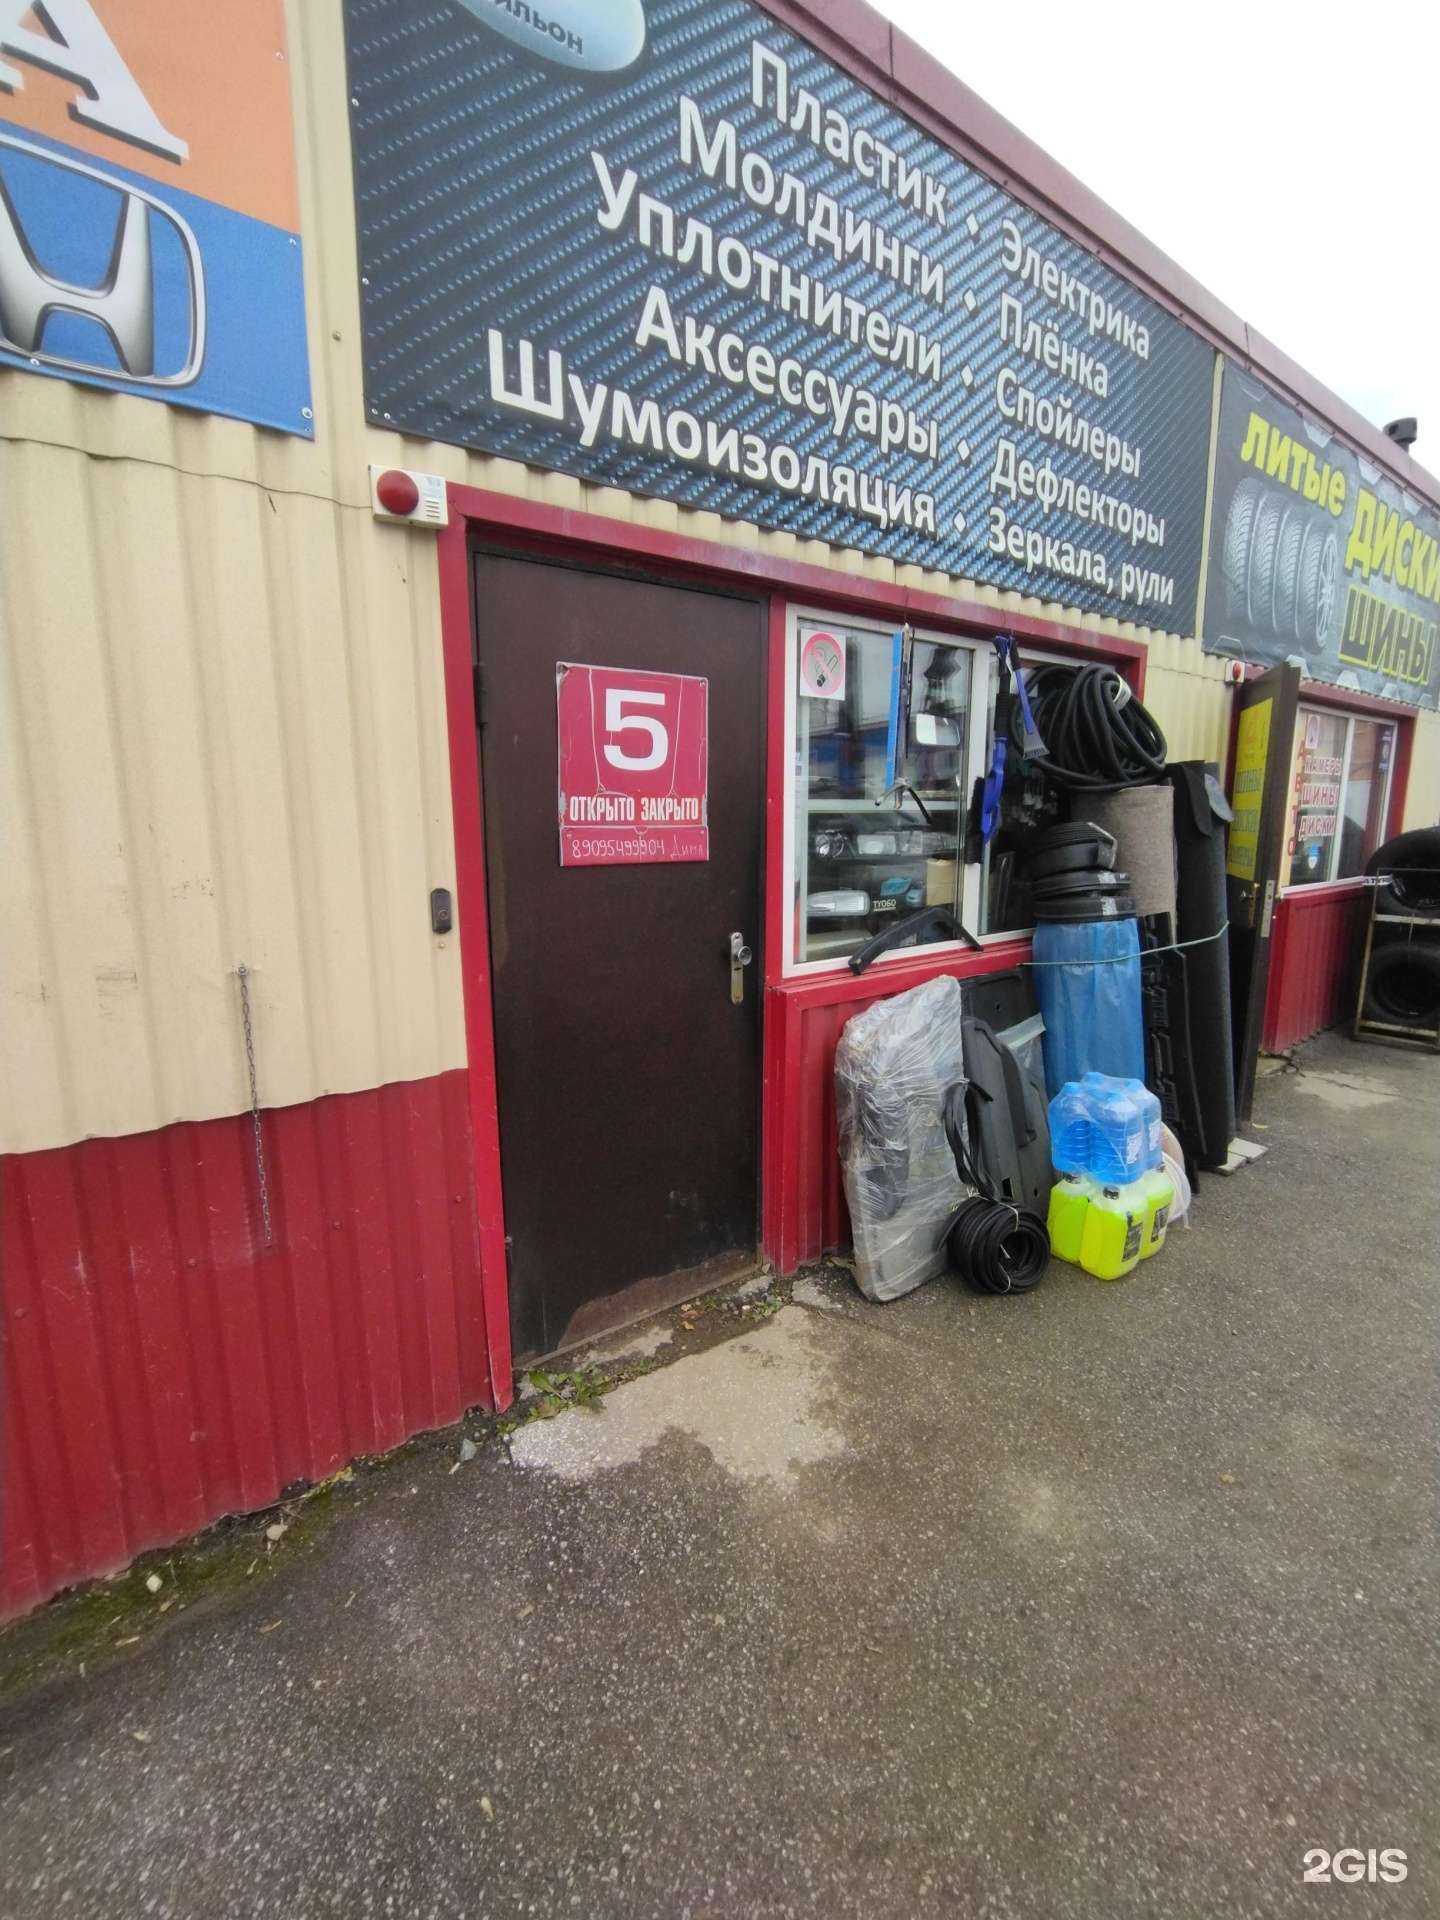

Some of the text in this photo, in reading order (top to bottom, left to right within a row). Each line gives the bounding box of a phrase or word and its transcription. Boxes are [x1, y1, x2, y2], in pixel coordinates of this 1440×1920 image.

[680, 95, 1109, 398] Молдинги Плёнка
[751, 40, 1151, 360] Пластик Электрика
[591, 152, 1141, 478] Уплотнители Спойлеры
[487, 330, 1174, 606] Шумоизоляция Зеркала, рули
[635, 285, 1165, 547] Аксессуары Дефлекторы
[1338, 585, 1438, 687] ШИНЫ
[1346, 490, 1440, 603] ДИСКИ
[569, 796, 699, 822] ОТКРЫТО ЗАКРЫТО
[604, 688, 669, 771] 5
[1300, 783, 1340, 807] ШИНЫ
